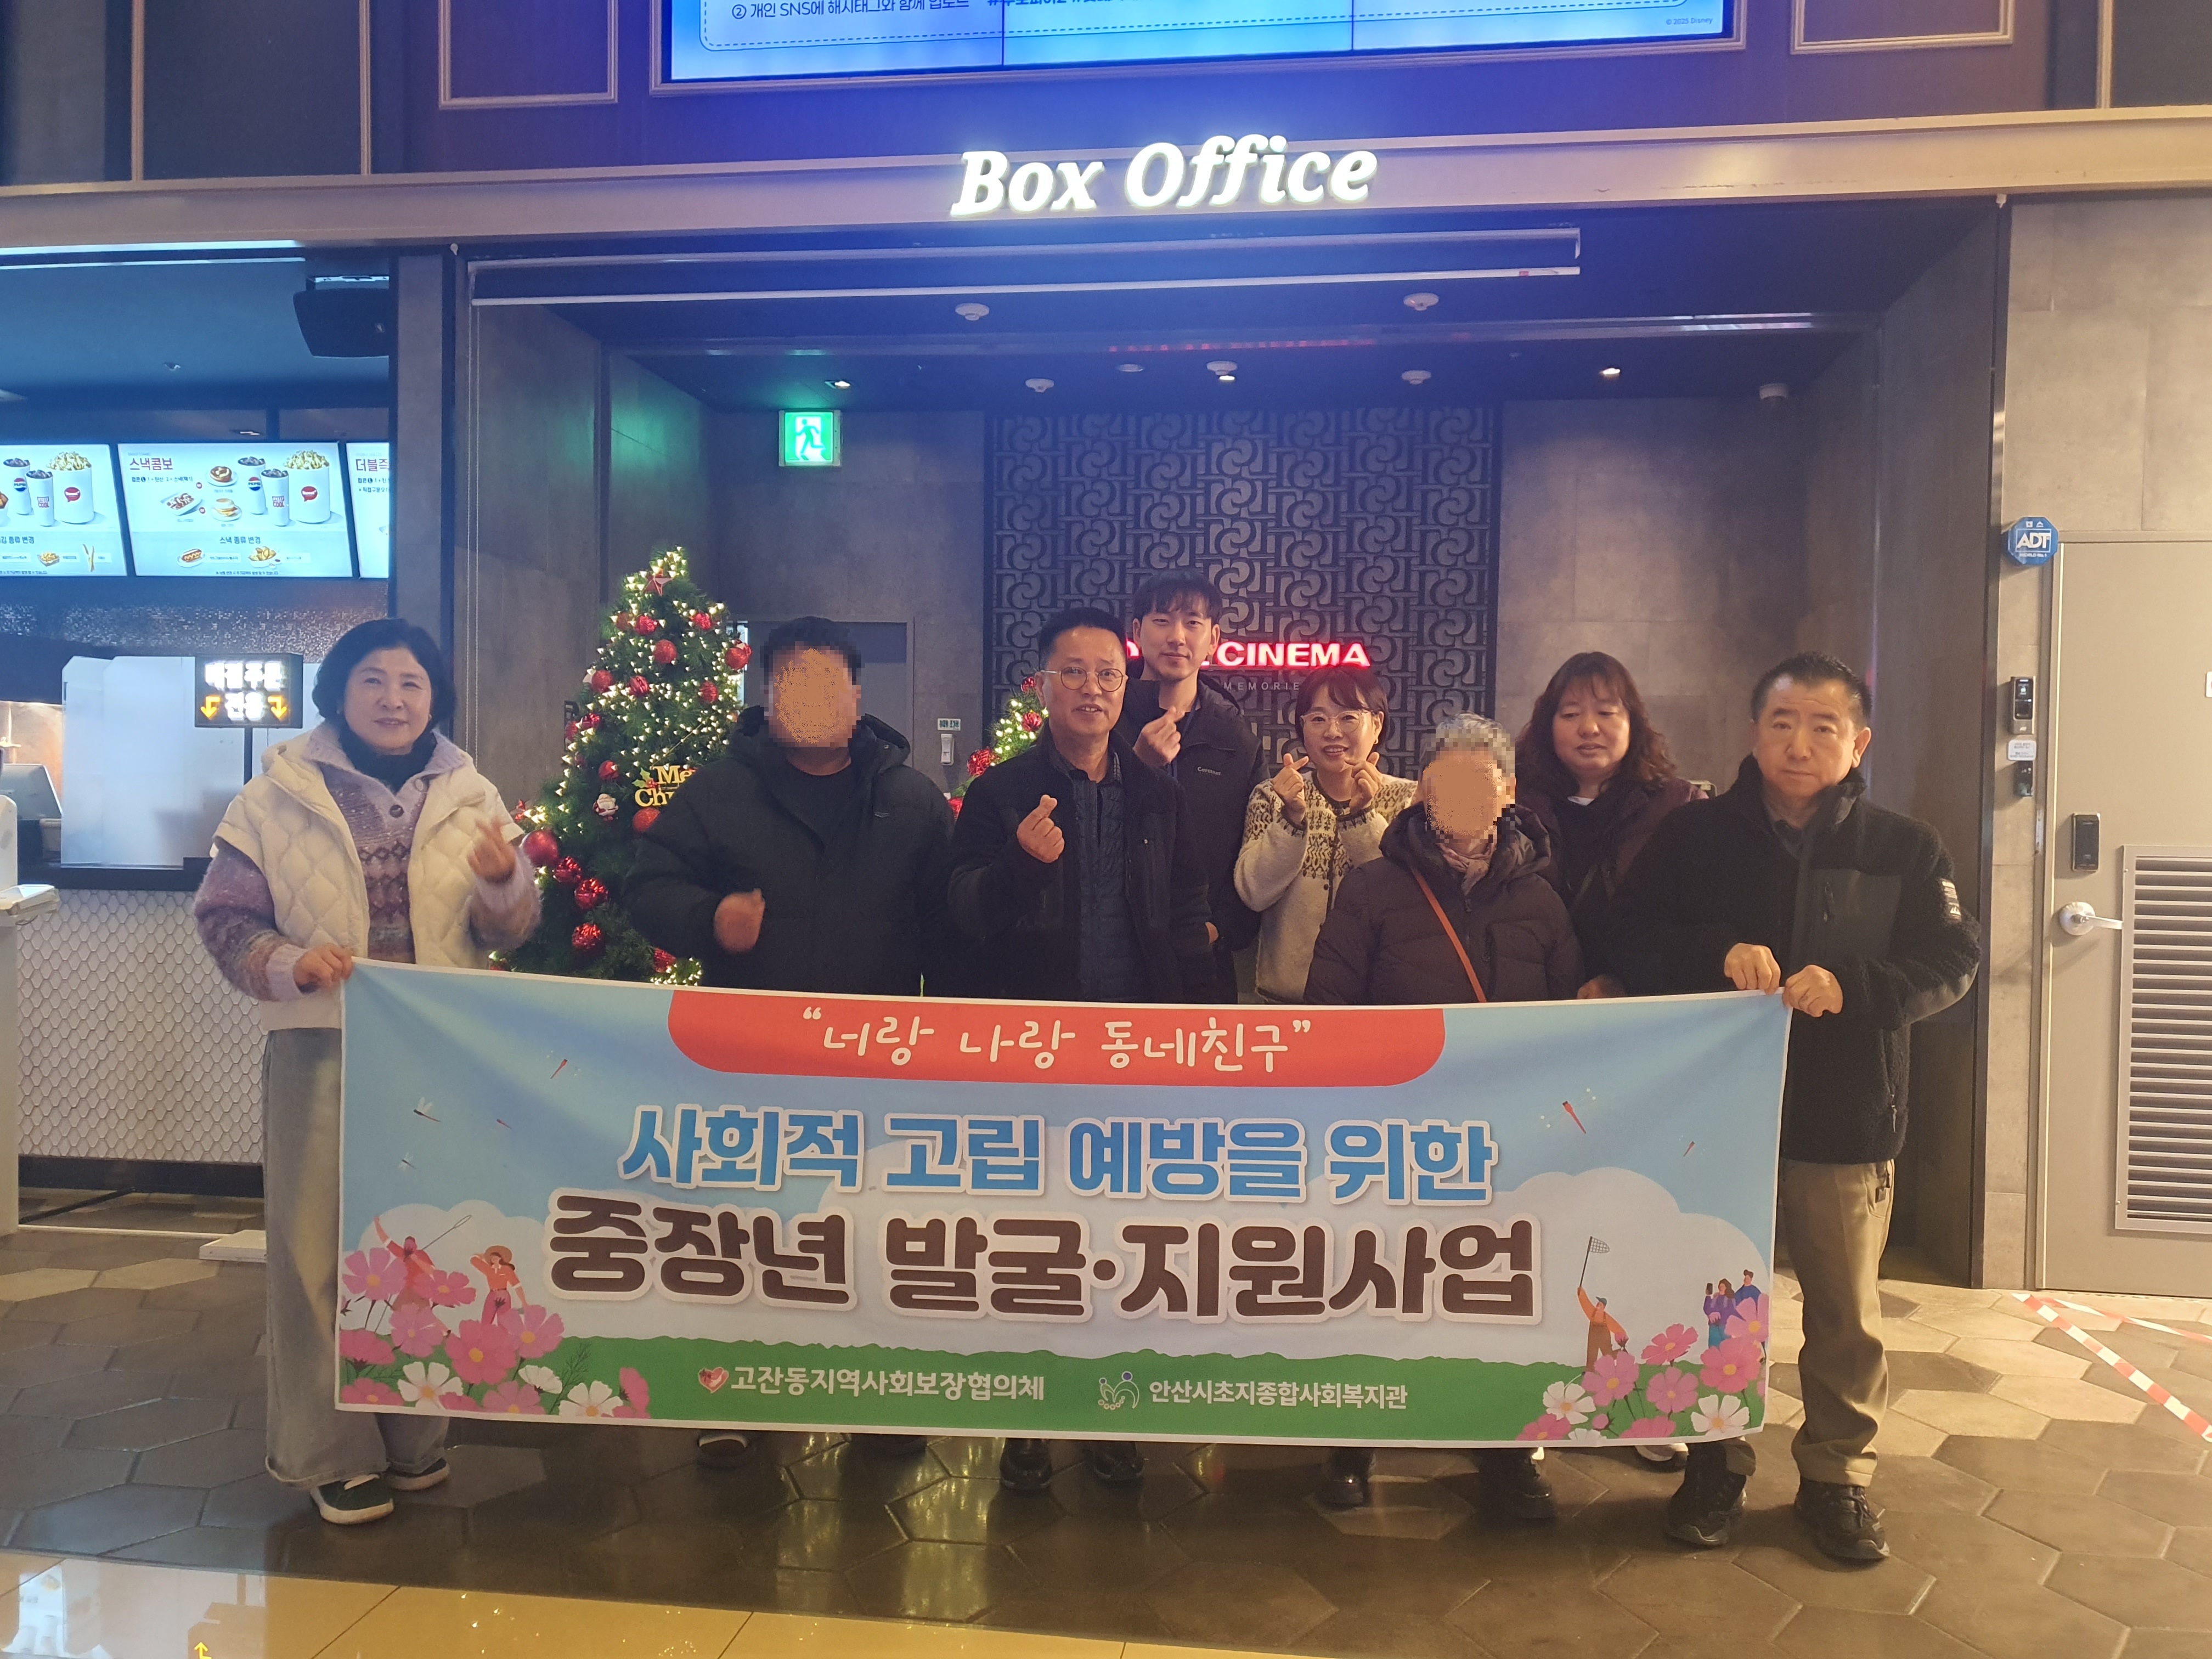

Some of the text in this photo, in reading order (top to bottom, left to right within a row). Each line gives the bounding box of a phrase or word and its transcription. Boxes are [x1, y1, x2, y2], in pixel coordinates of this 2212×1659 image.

[751, 3, 776, 18] 개인
[780, 1, 824, 16] SNS에
[828, 0, 895, 14] 해시태그와
[899, 0, 925, 10] 함께
[951, 134, 1379, 217] Box Office
[129, 458, 173, 471] 스낵콤보
[355, 459, 389, 472] 더블즉
[2016, 532, 2051, 549] ADT
[1216, 641, 1371, 668] CINEMA
[1224, 682, 1300, 691] MEMORIE
[649, 765, 692, 785] Me
[634, 787, 675, 807] Ch
[960, 1019, 1076, 1069] 나랑
[620, 1106, 1494, 1202] 사회적 고립 예방을 위한
[549, 1193, 851, 1307] 중장년
[730, 1365, 1045, 1401] 고잔동지역사회보장협의체
[1149, 1379, 1408, 1410] 안산시초지종합사회복지관
